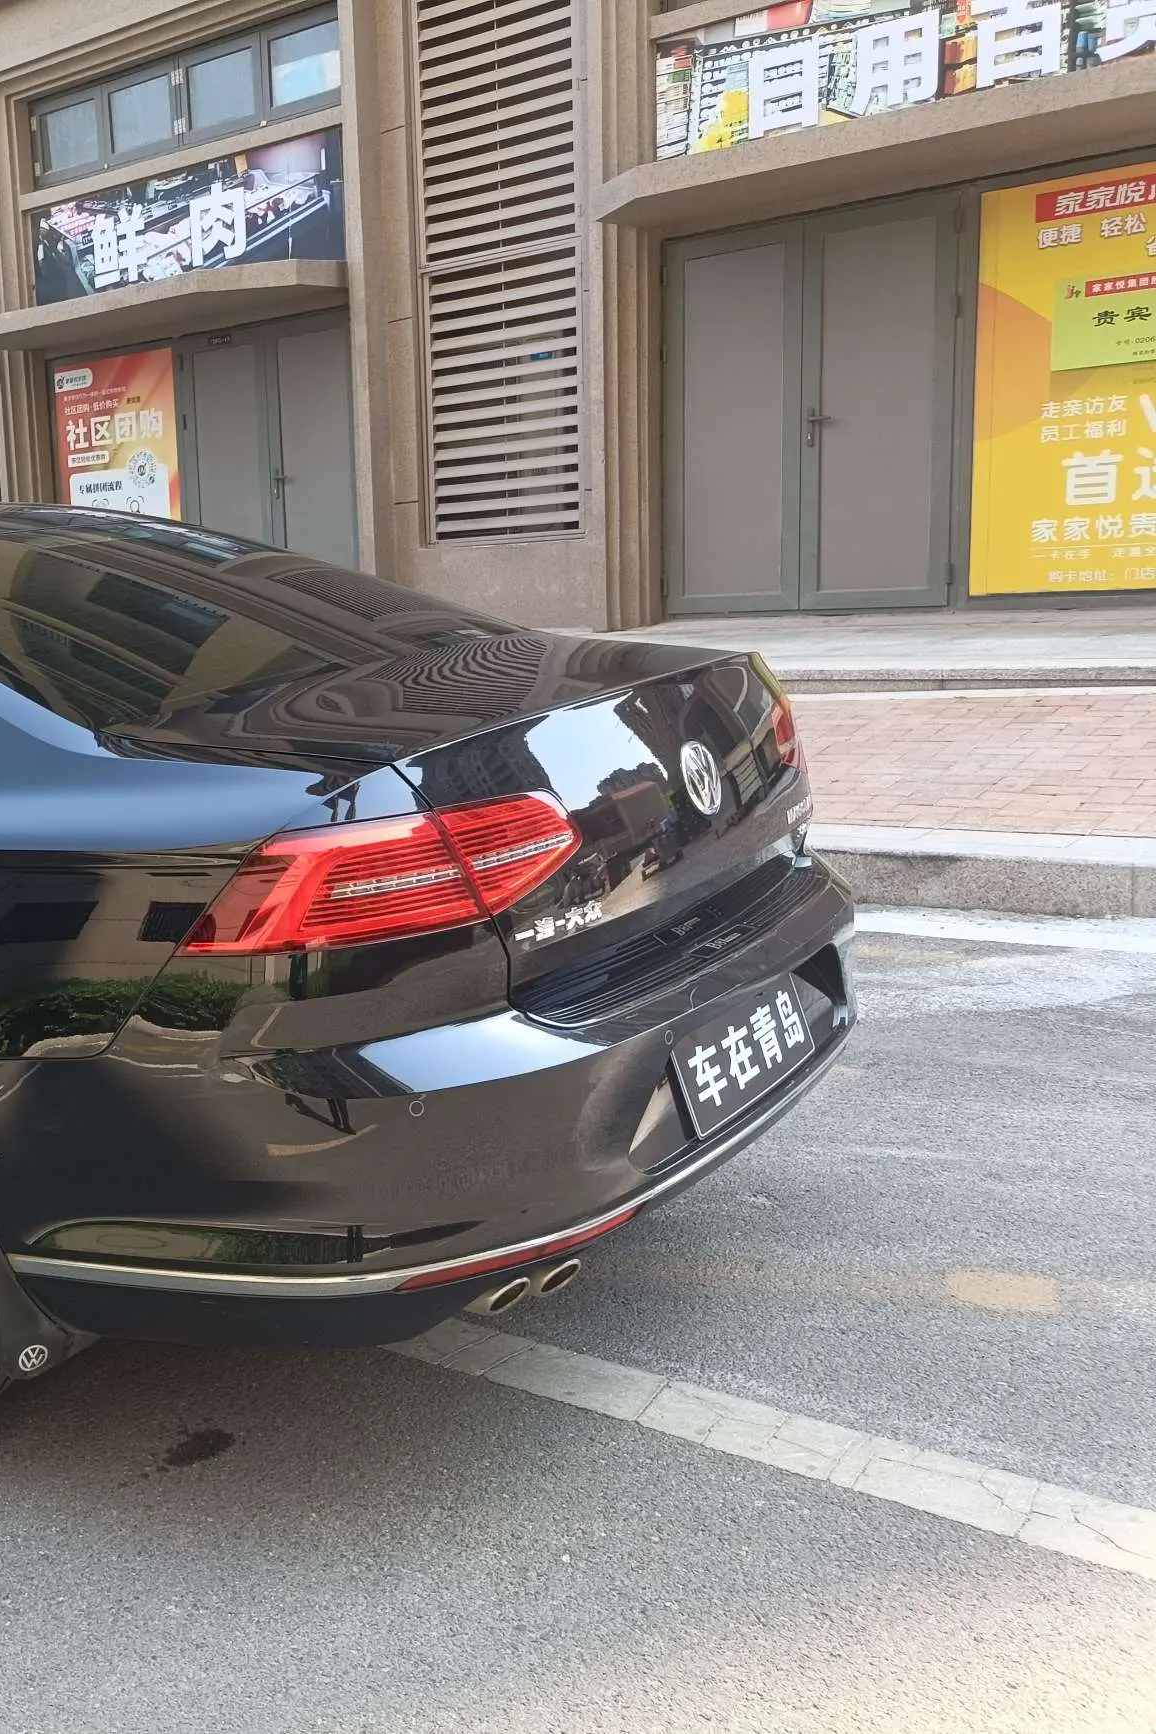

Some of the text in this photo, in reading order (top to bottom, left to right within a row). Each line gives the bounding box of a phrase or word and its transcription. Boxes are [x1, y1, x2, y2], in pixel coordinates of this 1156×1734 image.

[1054, 180, 1156, 216] 家家悦
[94, 180, 246, 289] 鲜肉
[1037, 213, 1147, 250] 便捷 轻松
[1040, 395, 1128, 420] 走亲访友
[66, 408, 163, 450] 社区团购
[1040, 419, 1127, 443] 员工福利
[687, 990, 805, 1107] 车在青岛
